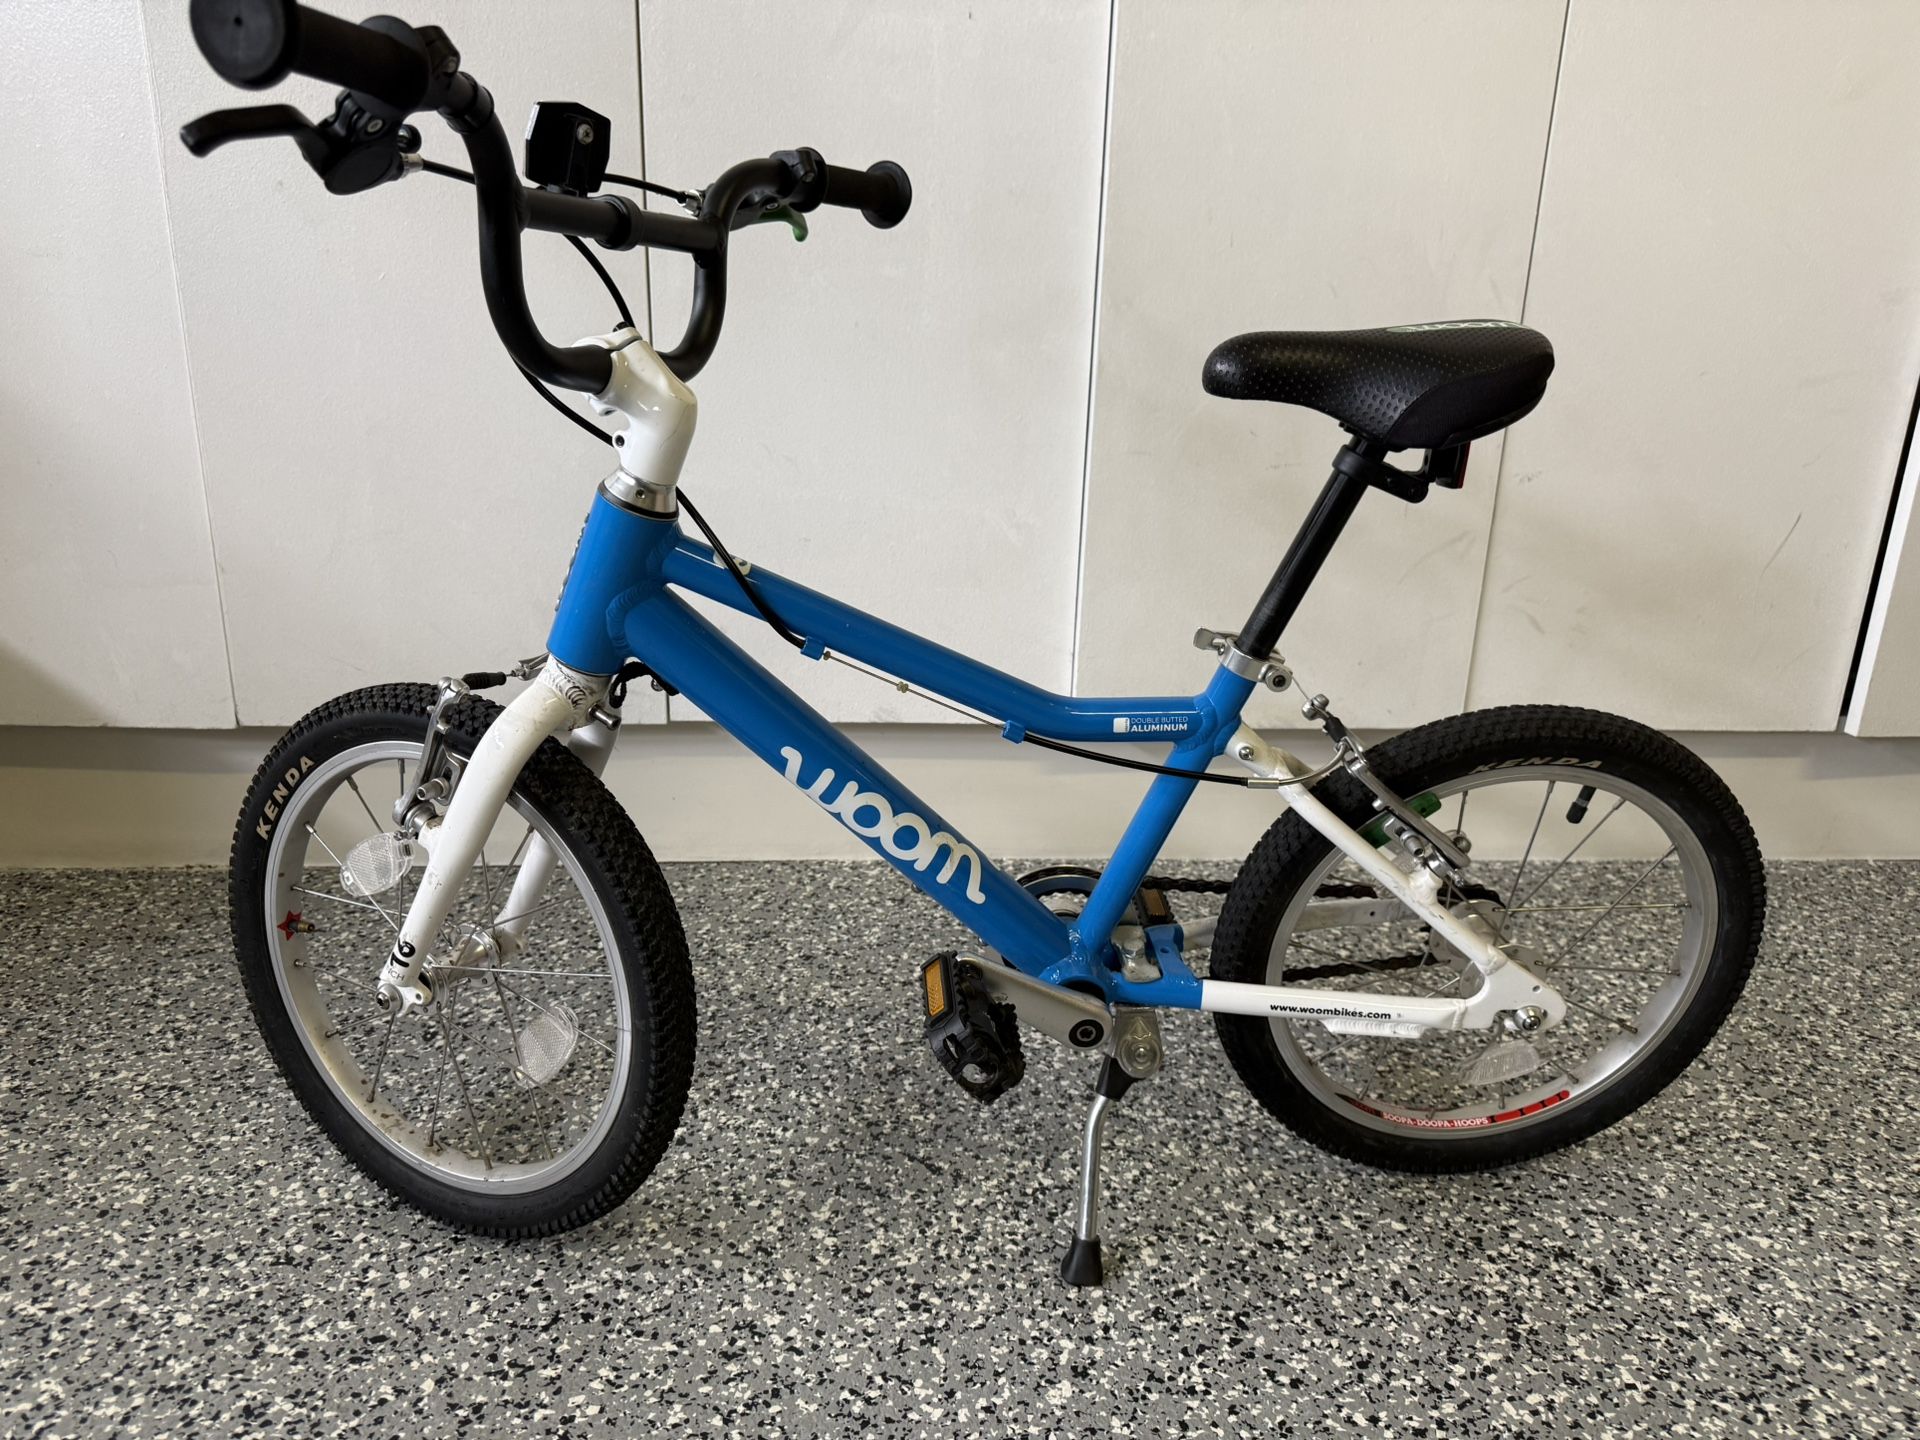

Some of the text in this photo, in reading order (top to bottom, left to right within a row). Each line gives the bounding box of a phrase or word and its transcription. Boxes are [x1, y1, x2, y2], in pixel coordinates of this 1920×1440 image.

[1130, 723, 1188, 733] ALUMINUM
[1468, 756, 1603, 774] KENDA
[256, 755, 315, 841] KENDA
[780, 746, 986, 904] woom
[390, 938, 416, 968] 16
[1269, 1004, 1392, 1020] www.woombikes.com
[1382, 1112, 1489, 1128] SOOPA-DOOPA-HOOPS
